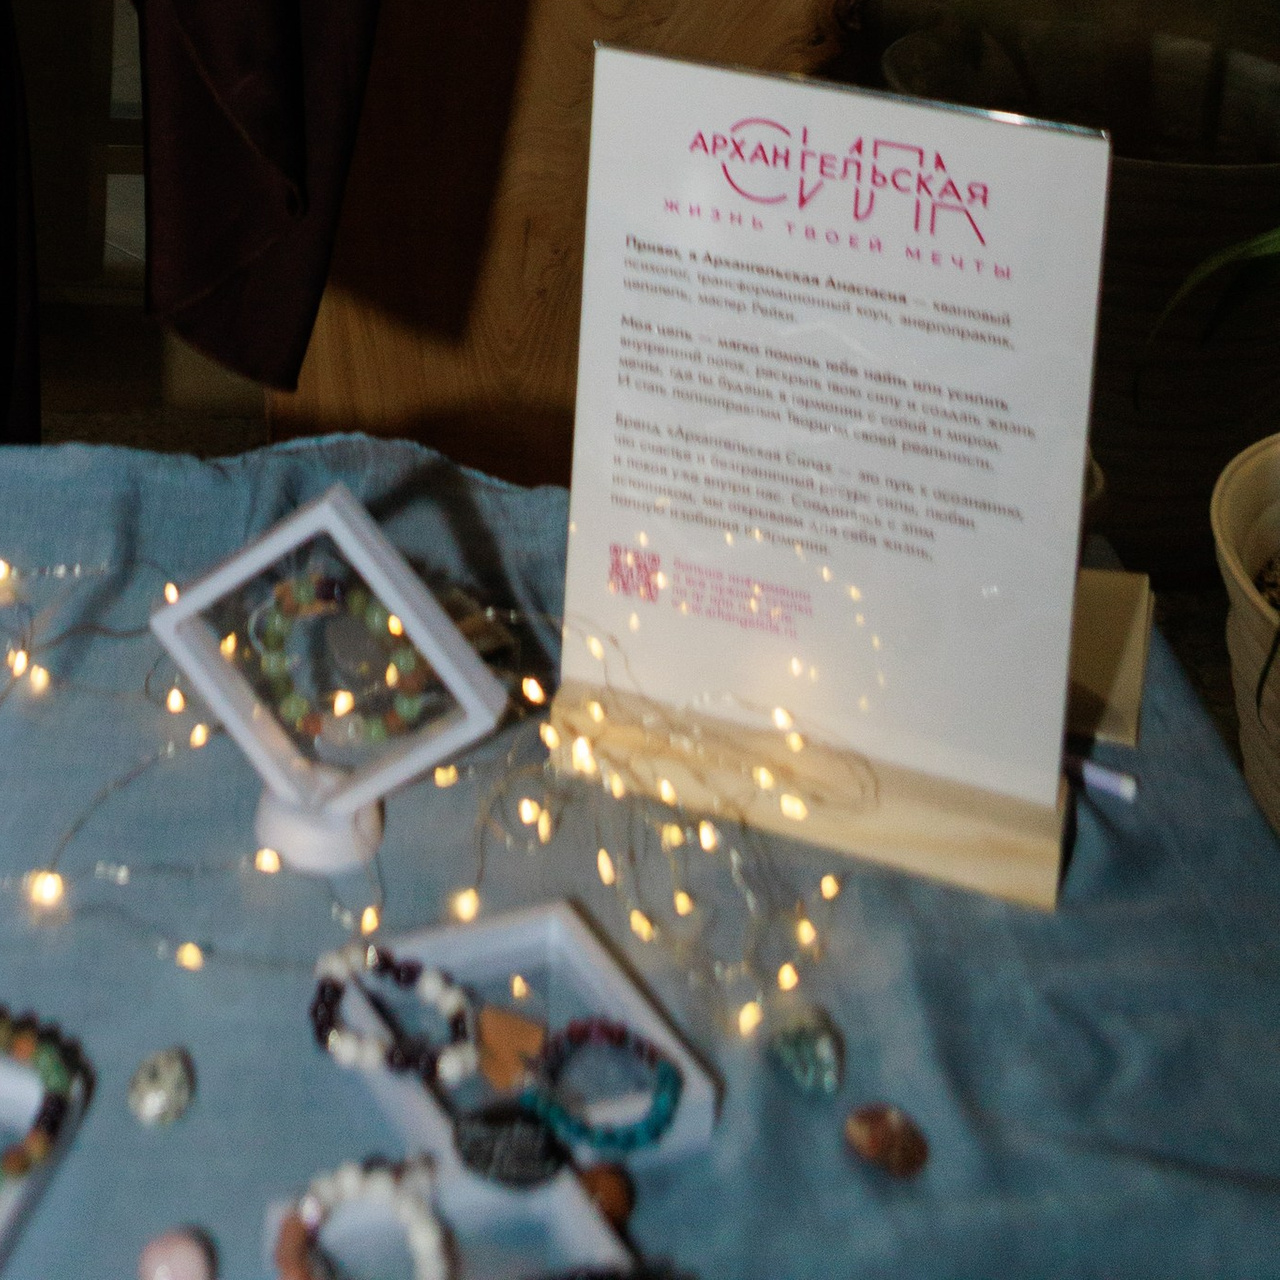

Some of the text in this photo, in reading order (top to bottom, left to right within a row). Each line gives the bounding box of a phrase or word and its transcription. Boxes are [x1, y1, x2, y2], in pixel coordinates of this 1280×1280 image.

[687, 128, 990, 209] АРХАНГЕЛЬСКАЯ
[662, 197, 1012, 280] ЖИЗНЬ ТВОЕЙ МЕЧТЫ
